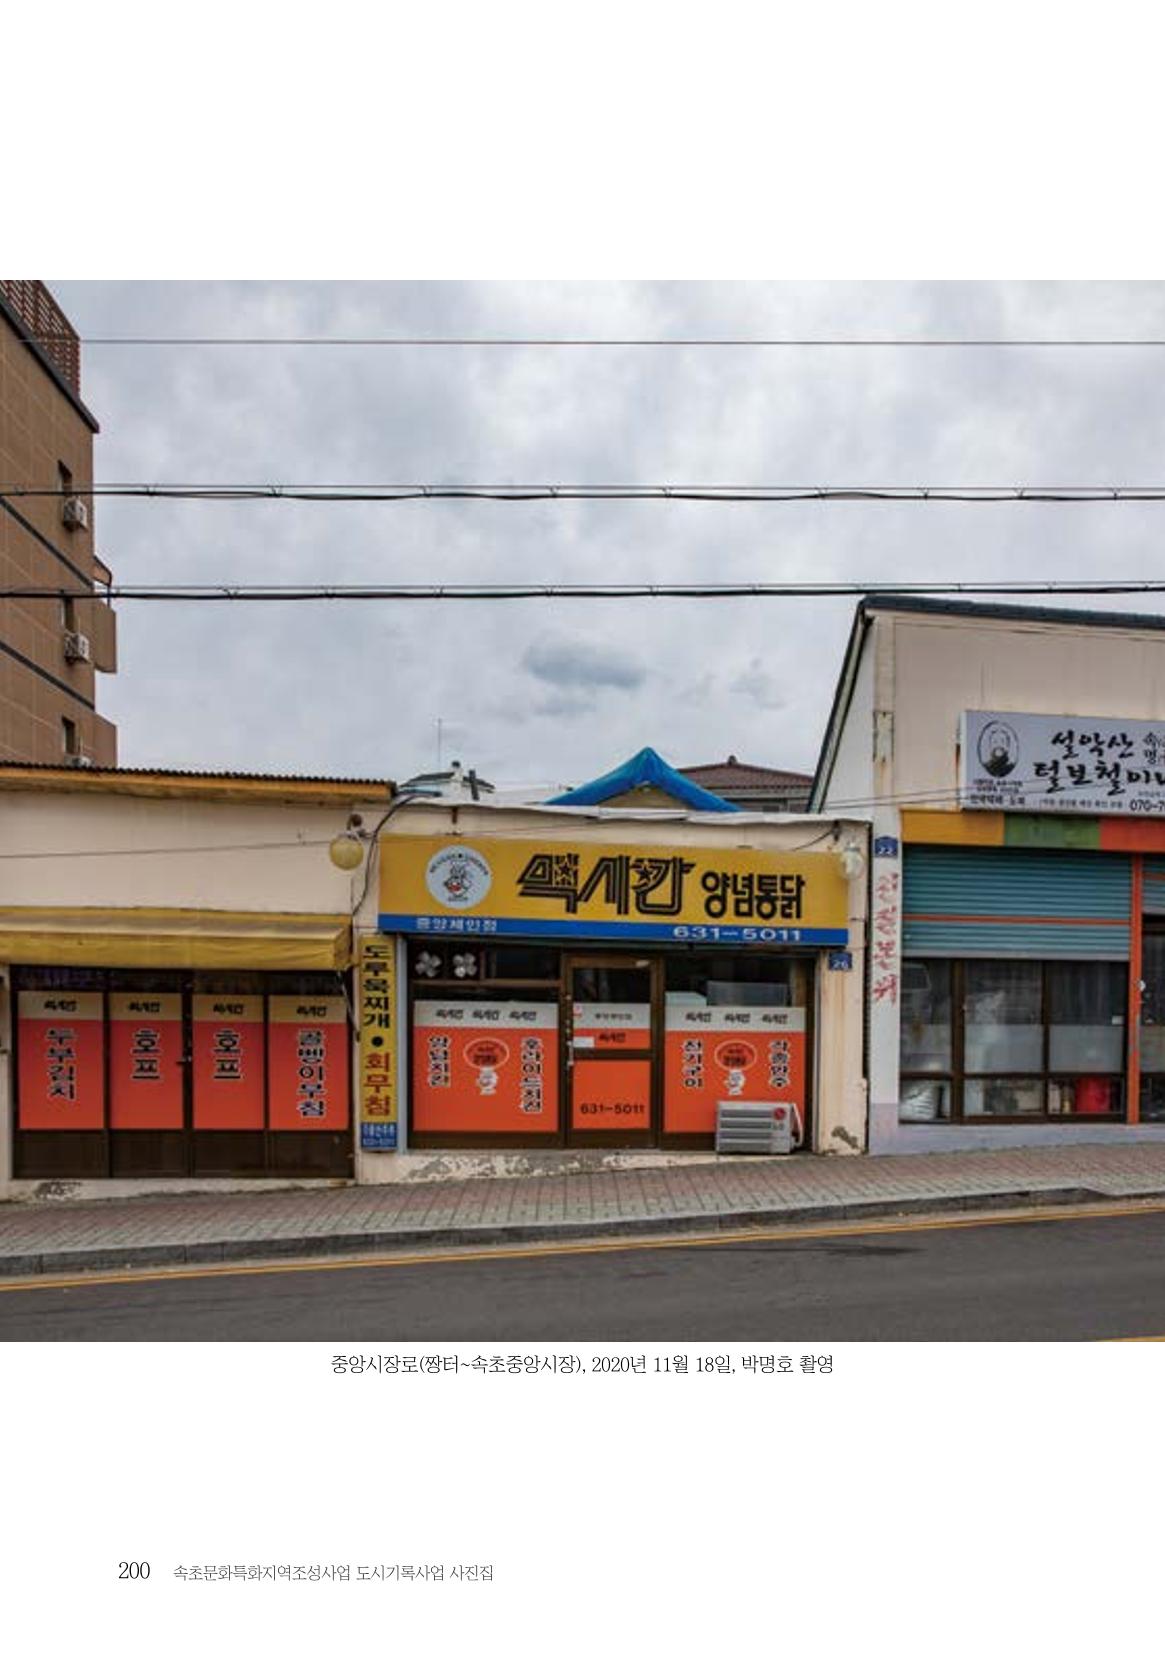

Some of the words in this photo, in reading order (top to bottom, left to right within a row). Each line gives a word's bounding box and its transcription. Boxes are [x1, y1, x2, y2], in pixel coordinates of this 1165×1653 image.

[1051, 729, 1134, 760] 설악산
[878, 846, 893, 855] 22
[701, 871, 805, 920] 양념통닭
[673, 926, 801, 941] 631-5011
[363, 945, 391, 1029] 도루묵찌개
[832, 959, 848, 970] 26
[47, 1028, 77, 1100] 두부김치
[131, 1030, 161, 1080] 호프
[213, 1030, 242, 1080] 호프
[364, 1052, 392, 1117] 회무침
[580, 1103, 645, 1115] 631-5011
